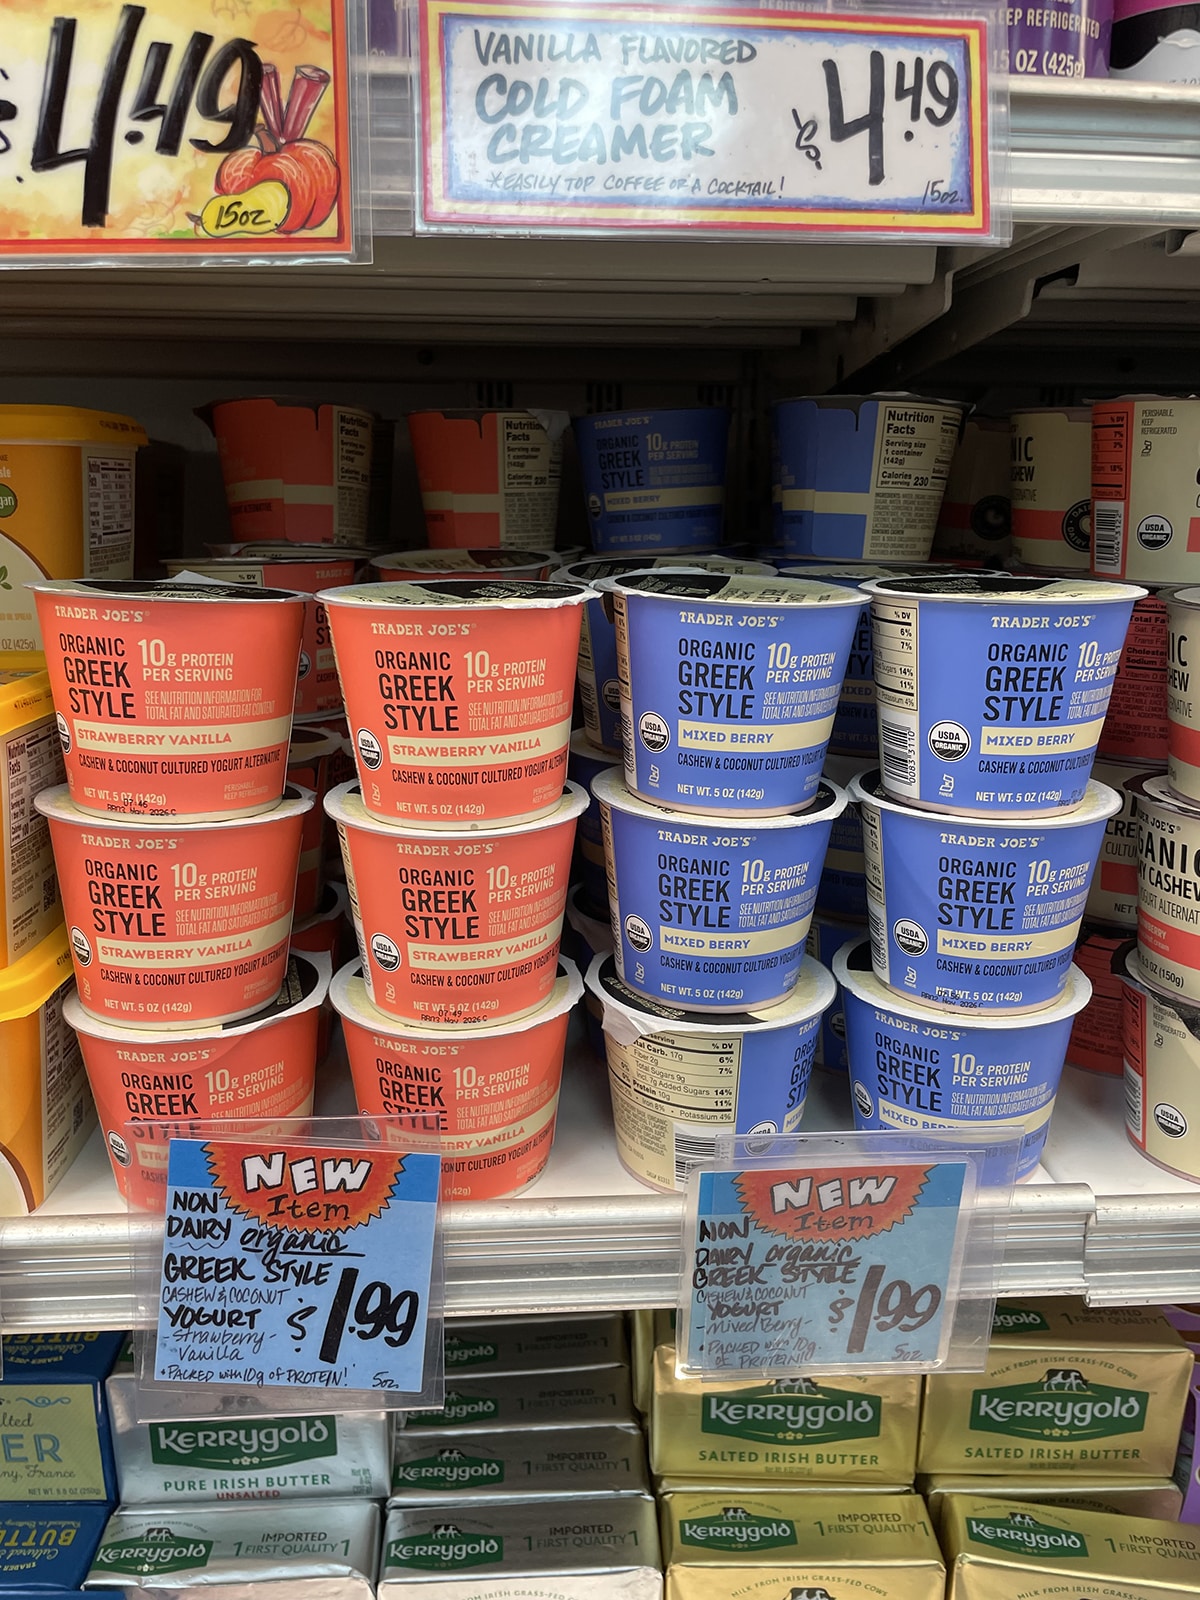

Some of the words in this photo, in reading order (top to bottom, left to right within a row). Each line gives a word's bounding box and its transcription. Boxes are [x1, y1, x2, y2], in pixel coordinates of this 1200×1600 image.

[1027, 11, 1100, 39] REFRIGERATED
[474, 29, 601, 66] VANILLA
[620, 35, 757, 66] FLAVORED
[1015, 49, 1037, 73] OZ
[1042, 50, 1086, 79] (425g)
[475, 73, 590, 124] COLD
[610, 69, 738, 120] FOAM
[487, 122, 715, 165] CREAMER
[565, 175, 595, 191] TOP
[603, 175, 664, 191] COFFEE
[707, 176, 785, 198] COCKTAIL!
[888, 410, 934, 423] Nutrition
[887, 424, 915, 435] Facts
[1141, 427, 1177, 435] REFRIGERATED
[885, 440, 912, 448] Serving
[598, 450, 641, 471] GREEK
[884, 457, 905, 465] (142g)
[601, 470, 644, 490] STYLE
[882, 471, 912, 480] Calories
[914, 477, 929, 486] 230
[1145, 523, 1165, 532] USDA
[55, 605, 98, 621] TRADER
[102, 609, 144, 622] JOE'S
[679, 611, 733, 626] TRADER
[738, 615, 779, 628] JOE'S
[59, 632, 125, 657] ORGANIC
[137, 638, 177, 667] 10g
[182, 653, 234, 667] PROTEIN
[678, 638, 756, 661] ORGANIC
[988, 643, 1069, 663] ORGANIC
[375, 650, 451, 671] ORGANIC
[767, 642, 798, 669] 10g
[800, 652, 836, 668] PROTEIN
[63, 657, 131, 688] GREEK
[143, 668, 170, 681] PER
[174, 668, 233, 682] SERVING
[496, 673, 545, 692] SERVING
[678, 660, 755, 691] GREEK
[985, 666, 1067, 693] GREEK
[378, 673, 456, 701] GREEK
[69, 688, 136, 719] STYLE
[678, 689, 755, 720] STYLE
[983, 695, 1064, 722] STYLE
[384, 703, 460, 732] STYLE
[644, 721, 662, 733] USDA
[77, 728, 165, 746] STRAWBERRY
[168, 732, 232, 746] VANILLA
[683, 729, 726, 743] MIXED
[730, 733, 774, 744] BERRY
[937, 731, 960, 741] USDA
[986, 735, 1033, 746] MIXED
[1037, 733, 1075, 745] BERRY
[392, 742, 488, 757] STRAWBERRY
[490, 737, 541, 756] VANILLA
[934, 742, 964, 751] ORGANIC
[79, 754, 107, 770] CASHEW
[116, 760, 159, 774] COCONUT
[161, 760, 209, 775] CULTURED
[211, 759, 243, 773] YOGURT
[244, 749, 281, 770] ALTERNATIVE
[737, 787, 765, 800] (142g)
[455, 802, 485, 816] (142g)
[88, 880, 163, 909] GREEK
[938, 877, 1016, 904] GREEK
[1050, 877, 1086, 895] SERVING
[664, 934, 705, 948] MIXED
[709, 939, 751, 950] BERRY
[101, 945, 194, 960] STRAWBERRY
[1159, 969, 1184, 988] (150g)
[647, 1045, 667, 1056] Carb.
[670, 1051, 683, 1061] 17g
[651, 1068, 675, 1080] Sugars
[633, 1080, 656, 1096] Protein
[659, 1078, 681, 1091] Added
[683, 1086, 710, 1096] Sugars
[877, 1074, 942, 1112] STYLE
[680, 1110, 717, 1120] Potassium
[882, 1106, 918, 1127] MIXED
[1160, 1109, 1179, 1124] USDA
[476, 1126, 525, 1148] VANILLA
[242, 1152, 373, 1195] NEW
[172, 1190, 219, 1214] NON
[770, 1175, 898, 1214] NEW
[268, 1193, 350, 1221] Item
[700, 1216, 750, 1243] NON
[794, 1212, 874, 1232] Item
[167, 1216, 231, 1240] DAIRY
[240, 1227, 349, 1261] organic
[696, 1242, 753, 1268] DAIRY
[164, 1253, 256, 1284] GREEK
[263, 1260, 333, 1286] STYLE
[692, 1264, 768, 1289] GREEK
[780, 1263, 857, 1284] STYLE
[162, 1286, 216, 1304] CASHEW
[230, 1287, 290, 1305] COCONUT
[754, 1284, 816, 1300] COCONUT
[162, 1307, 262, 1330] YOGURT
[287, 1268, 419, 1364] $1.99
[707, 1300, 784, 1321] YOGURT
[828, 1264, 942, 1354] $1.99
[178, 1347, 244, 1361] Vanilla
[1040, 1356, 1066, 1365] IRISH
[1068, 1356, 1116, 1372] GRASS-FED
[269, 1368, 285, 1380] of
[710, 1397, 874, 1430] Kerrygold
[979, 1395, 1140, 1426] Kerrygold
[158, 1422, 329, 1454] Kerrygold
[698, 1450, 759, 1463] SALTED
[764, 1452, 810, 1464] IRISH
[816, 1453, 879, 1466] BUTTER
[964, 1447, 1024, 1459] SALTED
[1030, 1449, 1074, 1460] IRISH
[1079, 1449, 1141, 1460] BUTTER
[398, 1462, 501, 1481] Kerrygold
[547, 1451, 607, 1461] IMPORTED
[163, 1479, 207, 1492] PURE
[213, 1478, 261, 1490] IRISH
[265, 1473, 331, 1487] BUTTER
[217, 1490, 281, 1500] UNSALTED
[838, 1512, 902, 1523] IMPORTED
[261, 1531, 328, 1542] IMPORTED
[684, 1522, 791, 1542] Kerrygold
[862, 1523, 916, 1536] QUALITY
[971, 1520, 1082, 1549] Kerrygold
[1129, 1534, 1196, 1550] IMPORTED
[281, 1542, 340, 1556] QUALITY
[390, 1539, 499, 1561] Kerrygold
[549, 1524, 613, 1535] IMPORTED
[96, 1544, 207, 1564] Kerrygold
[811, 1574, 862, 1588] GRASS-FED
